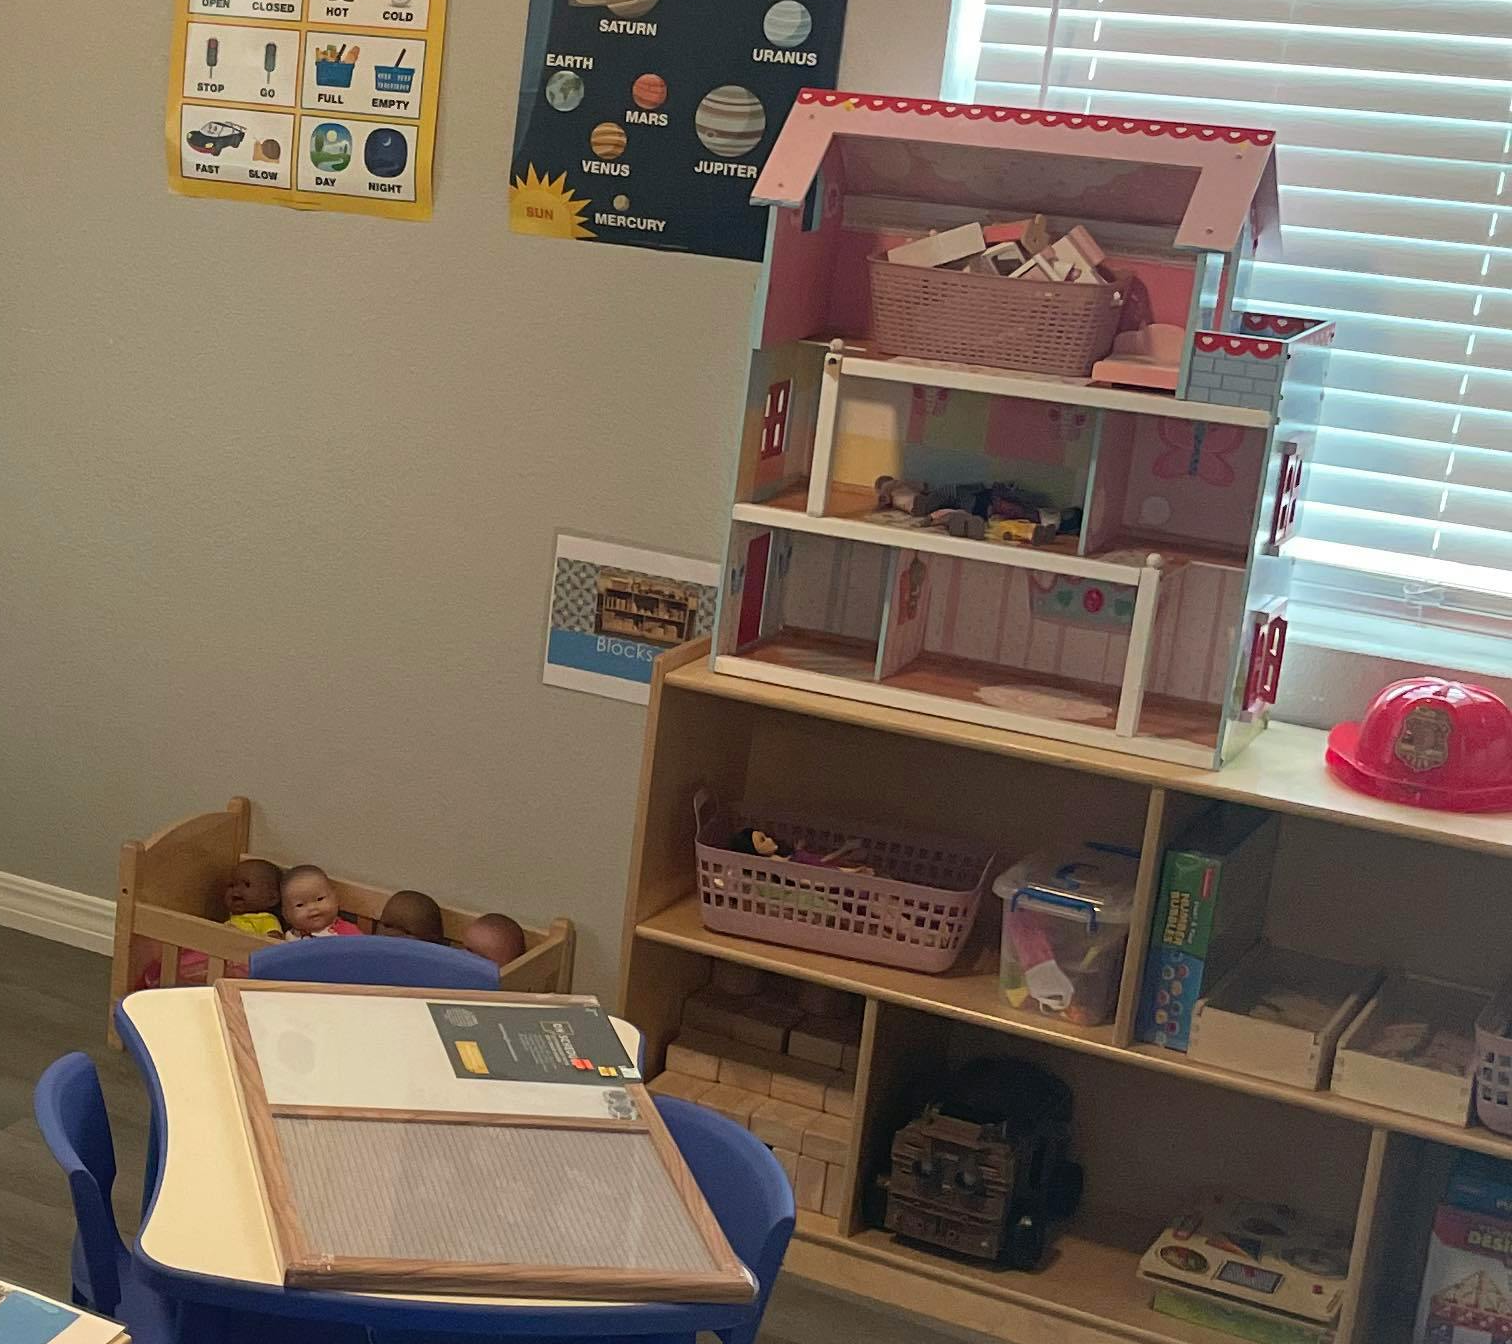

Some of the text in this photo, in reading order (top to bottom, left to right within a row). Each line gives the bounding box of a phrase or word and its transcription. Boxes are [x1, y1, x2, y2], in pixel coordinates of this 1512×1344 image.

[252, 1, 295, 14] CLOSED
[326, 6, 414, 22] HOT COLD
[599, 18, 657, 36] SATURN
[546, 54, 594, 70] EARTH
[752, 49, 817, 66] URANUS
[197, 82, 275, 98] STOP GO
[317, 93, 409, 111] FULL EMPTY
[625, 110, 668, 126] MARS
[195, 163, 278, 181] FAST SLOW
[582, 160, 630, 177] VENUS
[694, 161, 757, 179] JUPITER
[315, 177, 402, 194] DAY NIGHT
[526, 206, 554, 221] SUN
[594, 213, 666, 232] MERCURY
[596, 636, 653, 662] Blocks
